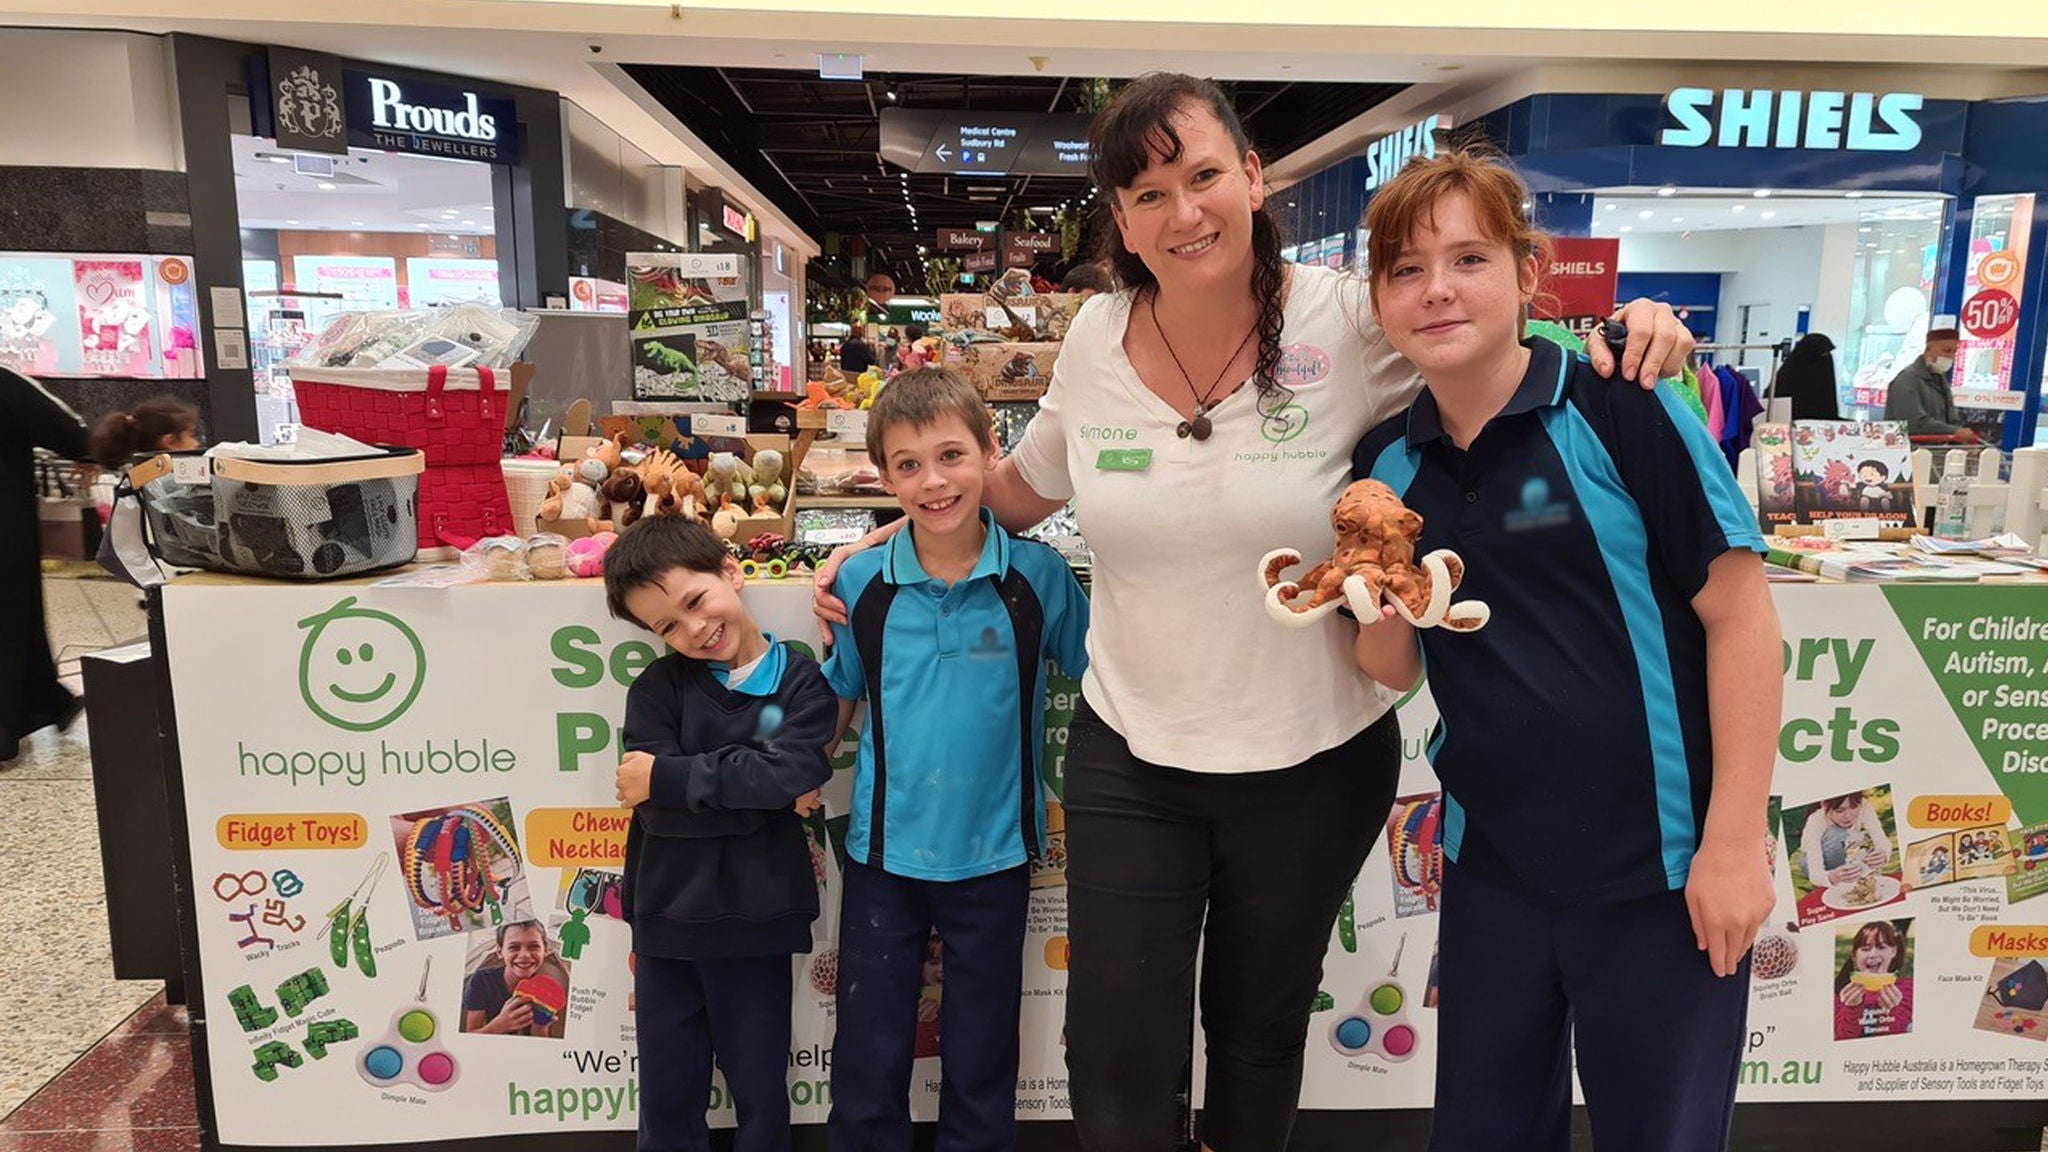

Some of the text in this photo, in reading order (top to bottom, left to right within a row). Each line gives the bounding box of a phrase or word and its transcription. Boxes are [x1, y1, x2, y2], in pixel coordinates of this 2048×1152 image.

[367, 77, 497, 141] Prouds
[1661, 87, 1924, 151] SHIELS
[960, 126, 1017, 137] Medical Centre
[374, 133, 498, 159] THE JEWELLERS
[960, 138, 1005, 148] Sudbury Rd
[950, 233, 984, 249] Bakery
[1014, 236, 1051, 248] Seafood
[1549, 261, 1605, 275] SHIELS
[1235, 449, 1327, 463] happy hubble
[1809, 511, 1908, 521] HELP YOUR DRAGON
[1923, 617, 1963, 641] For
[550, 625, 657, 689] Se
[1944, 650, 2035, 678] Autism,
[1962, 689, 1989, 707] or
[1778, 707, 1901, 764] cts
[238, 738, 516, 787] happy hubble
[1926, 802, 1993, 822] Books!
[227, 819, 359, 847] Fidget Toys!
[245, 939, 301, 962] Wacky Tracks
[1937, 975, 1953, 983] Face
[1954, 975, 1972, 983] Mask
[571, 986, 607, 998] Push Pop
[570, 1003, 593, 1013] Fidget
[570, 1011, 583, 1021] Toy
[1843, 1060, 1870, 1075] Happy
[1871, 1060, 1900, 1073] Hubble
[1902, 1059, 1937, 1072] Australia
[1940, 1059, 1947, 1072] is
[1948, 1062, 1954, 1072] a
[1956, 1059, 2006, 1074] Homegrown
[2008, 1058, 2041, 1074] Therapy
[1857, 1079, 1873, 1091] and
[1875, 1078, 1909, 1093] Supplier
[1910, 1077, 1919, 1091] of
[1920, 1077, 1955, 1092] Sensory
[1957, 1076, 1977, 1090] Tools
[1979, 1077, 1995, 1090] and
[1997, 1076, 2024, 1092] Fidget
[381, 1092, 427, 1106] Dimple Mate
[1015, 1097, 1047, 1112] ensory
